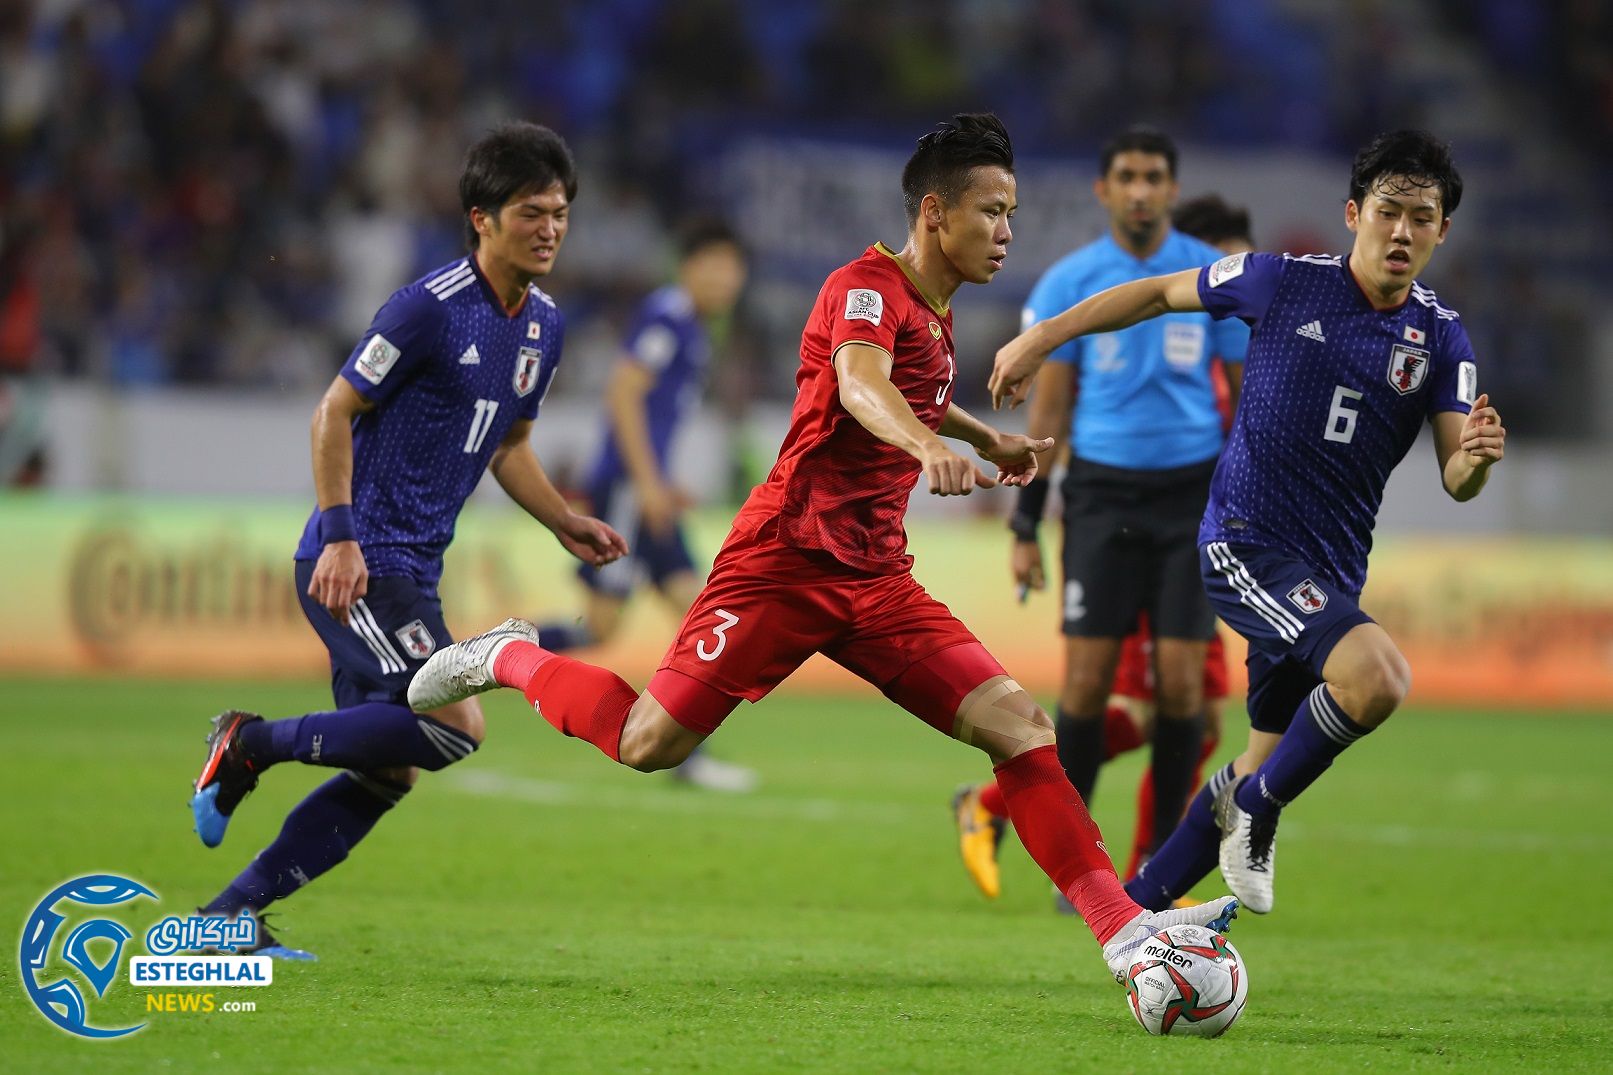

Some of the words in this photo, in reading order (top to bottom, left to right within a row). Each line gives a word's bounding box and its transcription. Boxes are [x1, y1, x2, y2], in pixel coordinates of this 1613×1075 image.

[463, 398, 499, 453] 11
[1323, 384, 1363, 444] 6
[696, 608, 740, 661] 3
[1144, 945, 1193, 967] molten
[1145, 976, 1166, 988] OFFICIAL
